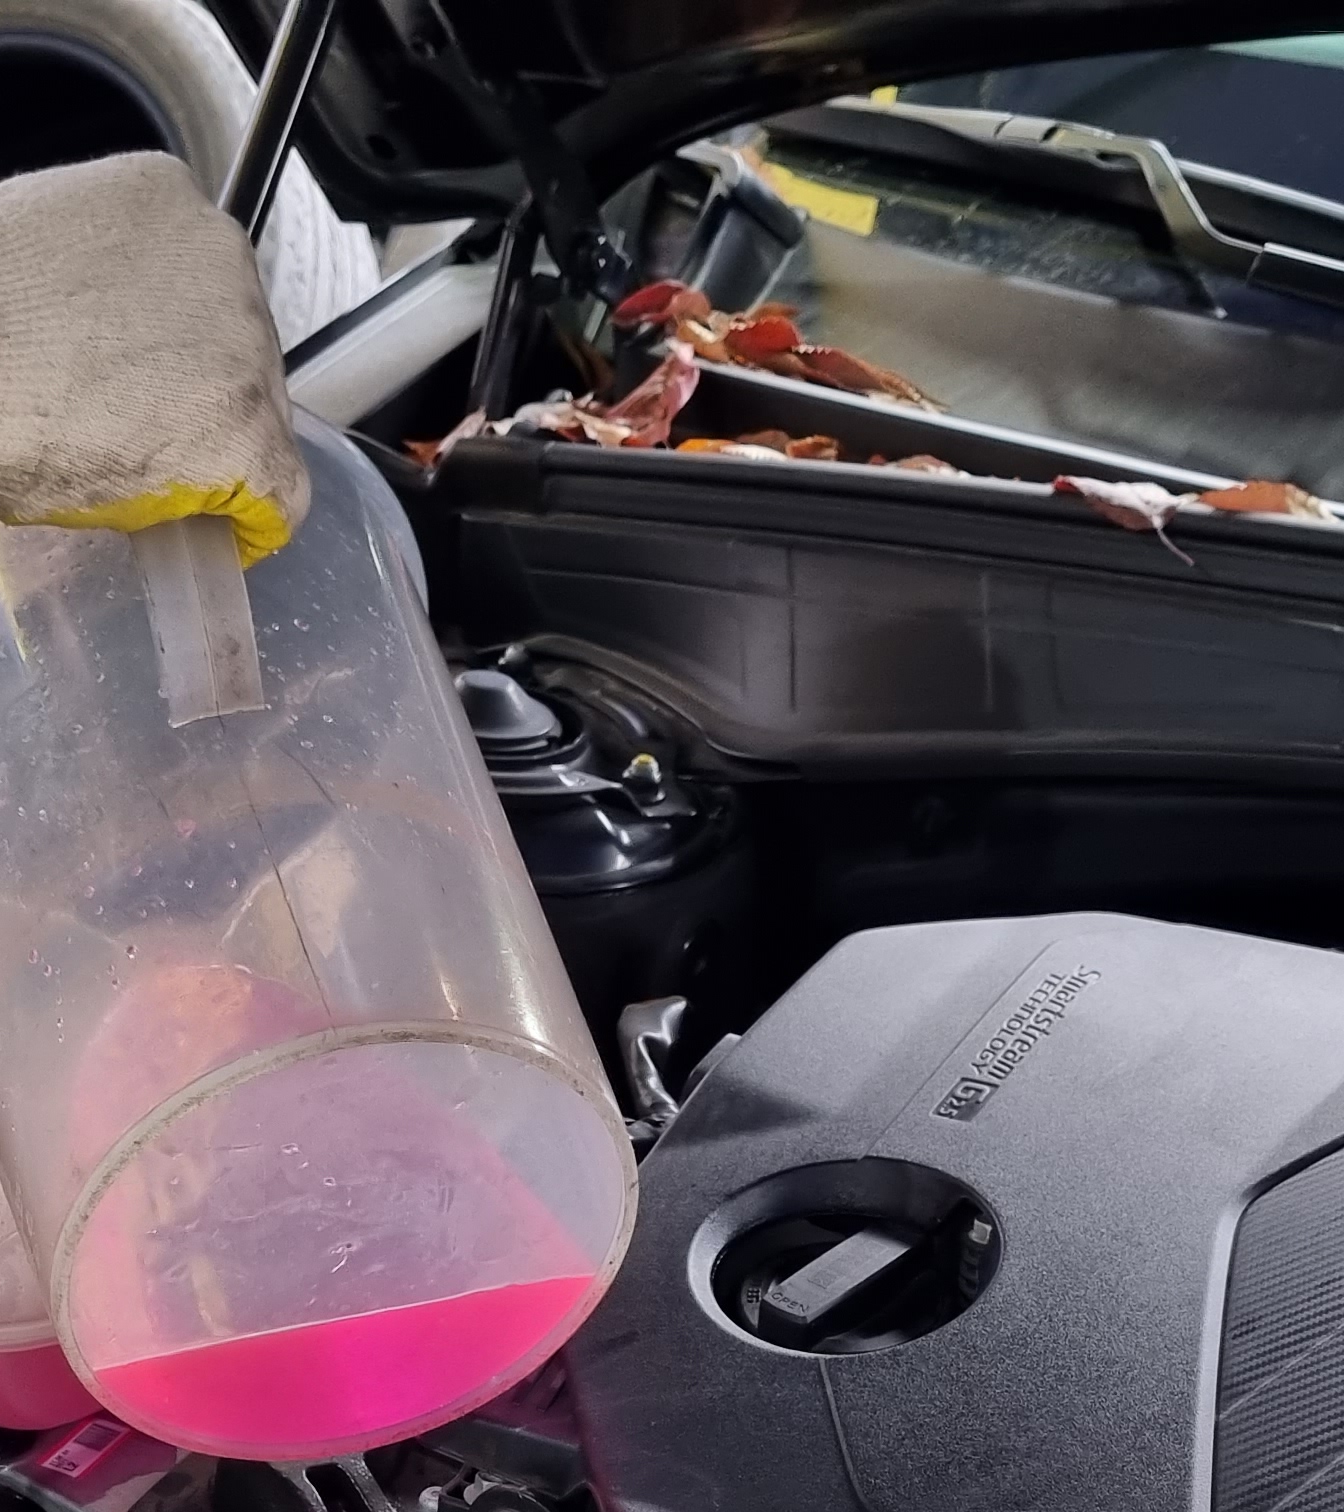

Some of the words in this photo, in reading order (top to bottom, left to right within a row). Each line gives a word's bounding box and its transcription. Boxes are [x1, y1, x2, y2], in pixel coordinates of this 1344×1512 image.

[971, 973, 1066, 1076] TECHNOLOGY
[987, 964, 1102, 1080] Smartstream
[771, 1291, 810, 1314] OPEN
